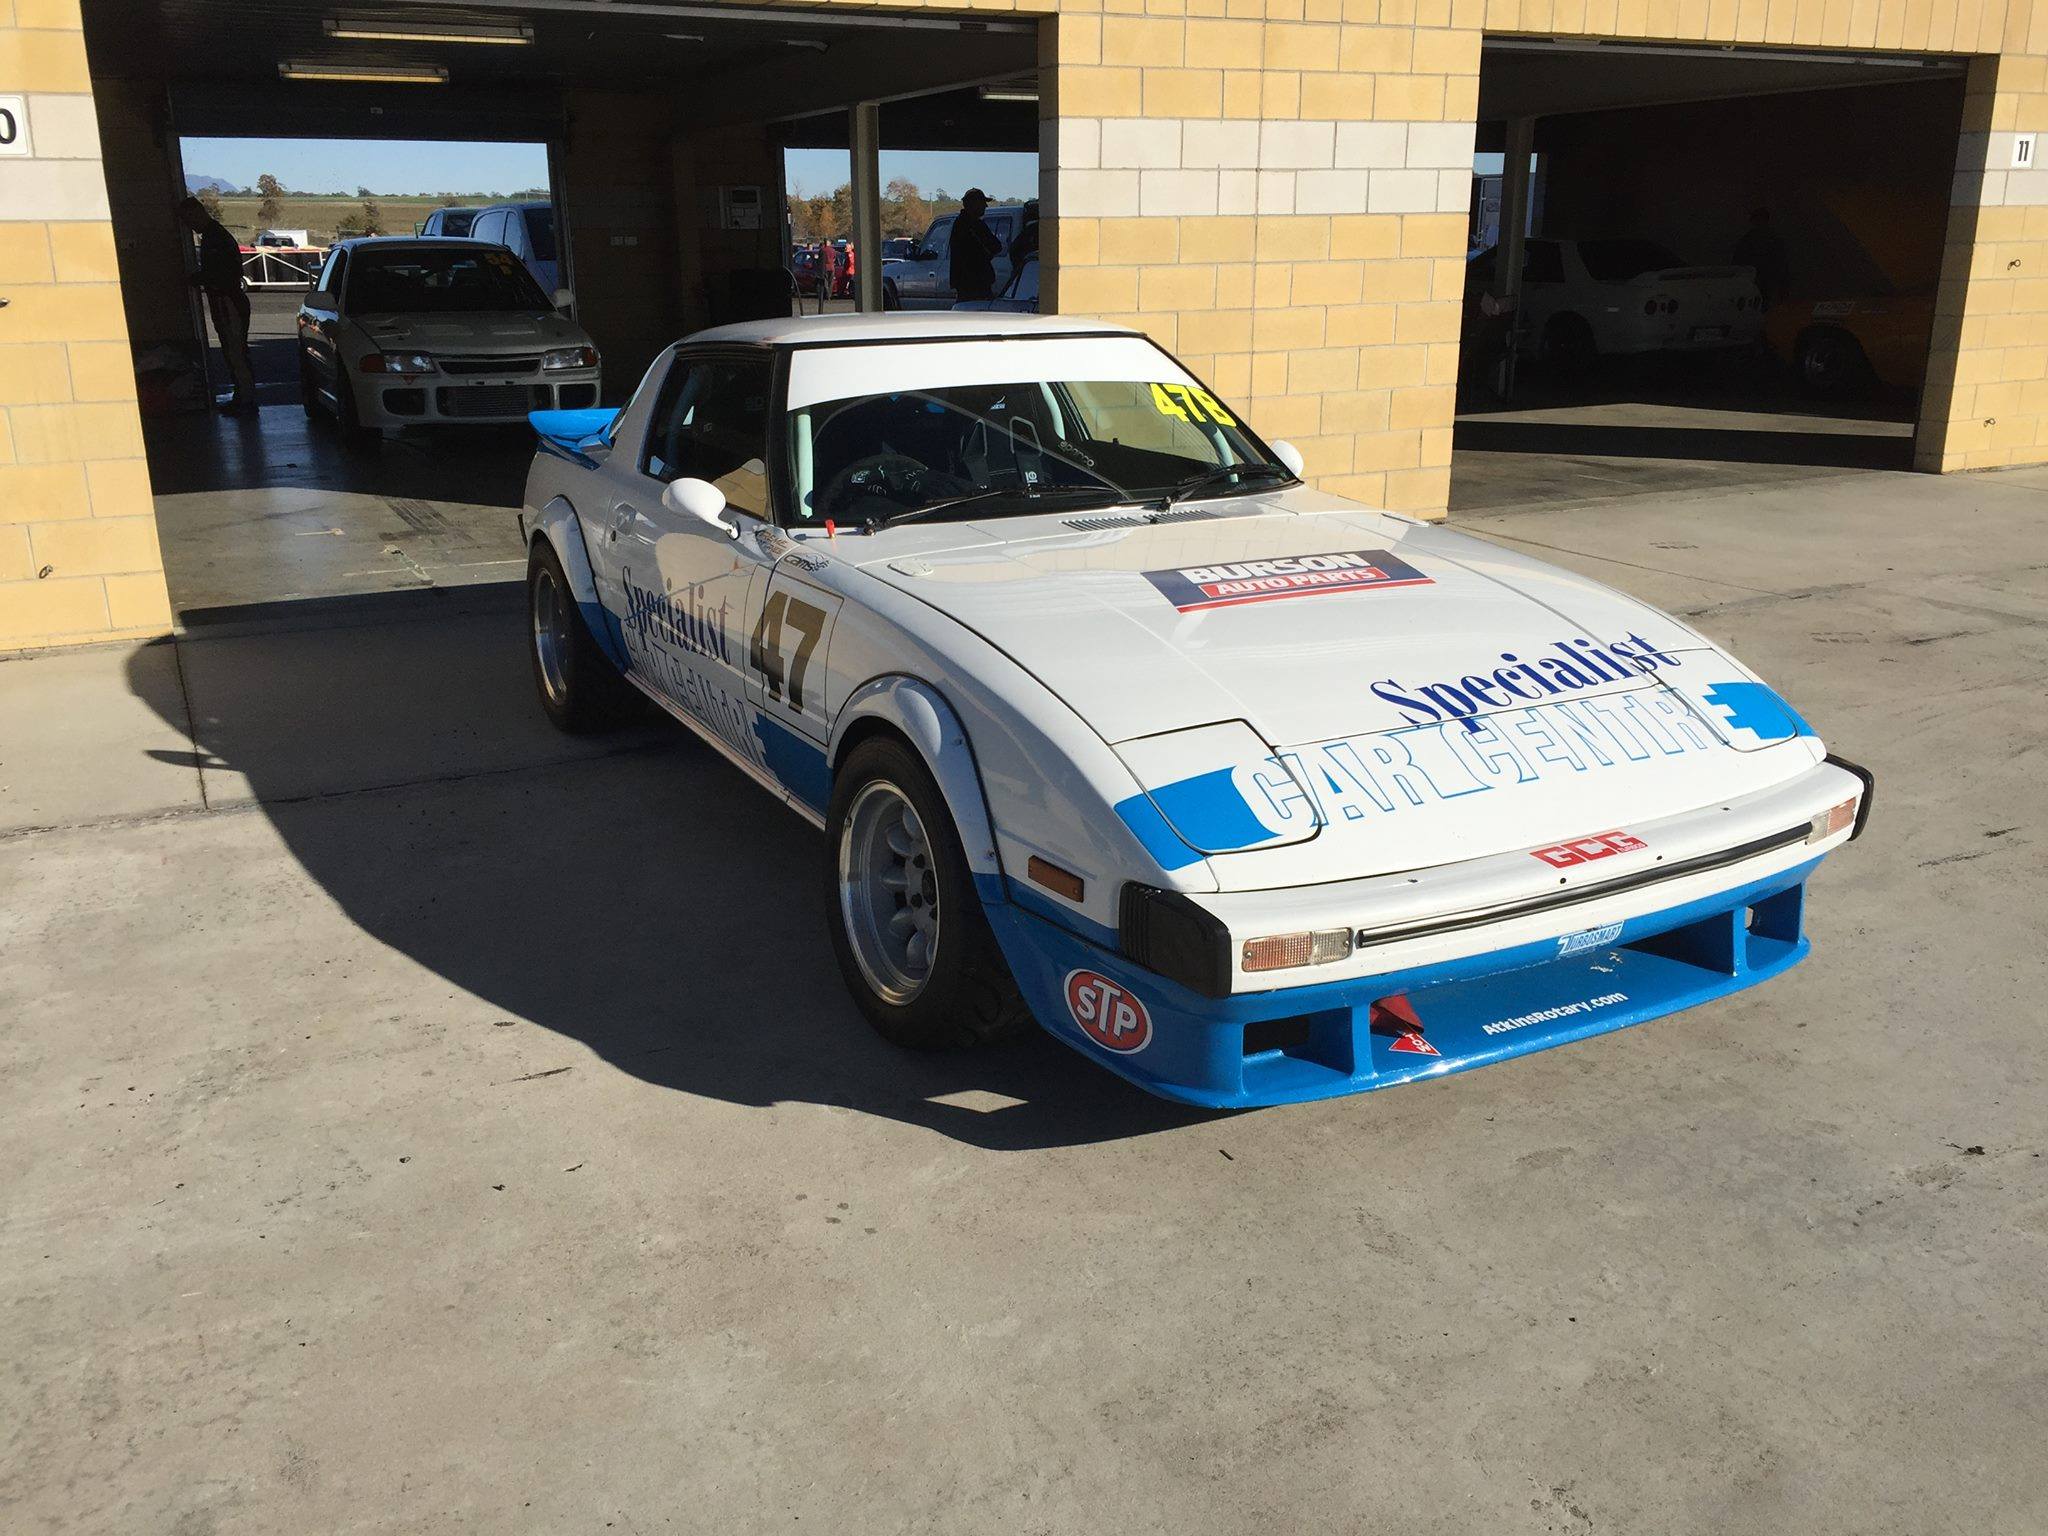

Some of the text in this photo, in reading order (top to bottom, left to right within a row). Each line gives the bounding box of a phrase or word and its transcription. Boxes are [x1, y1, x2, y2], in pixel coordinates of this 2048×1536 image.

[2017, 140, 2030, 162] 11
[1177, 553, 1371, 584] BURSON
[1216, 569, 1377, 595] AUTO PARTS
[622, 566, 735, 665] Specialist
[750, 590, 827, 714] 47
[1370, 631, 1681, 734] Specialist
[1231, 683, 1761, 836] CAR CENTRE
[1529, 831, 1648, 869] GCG
[1077, 979, 1137, 1037] STP
[1482, 992, 1628, 1036] AtkinsRotary.com
[1405, 1033, 1432, 1052] TOW
